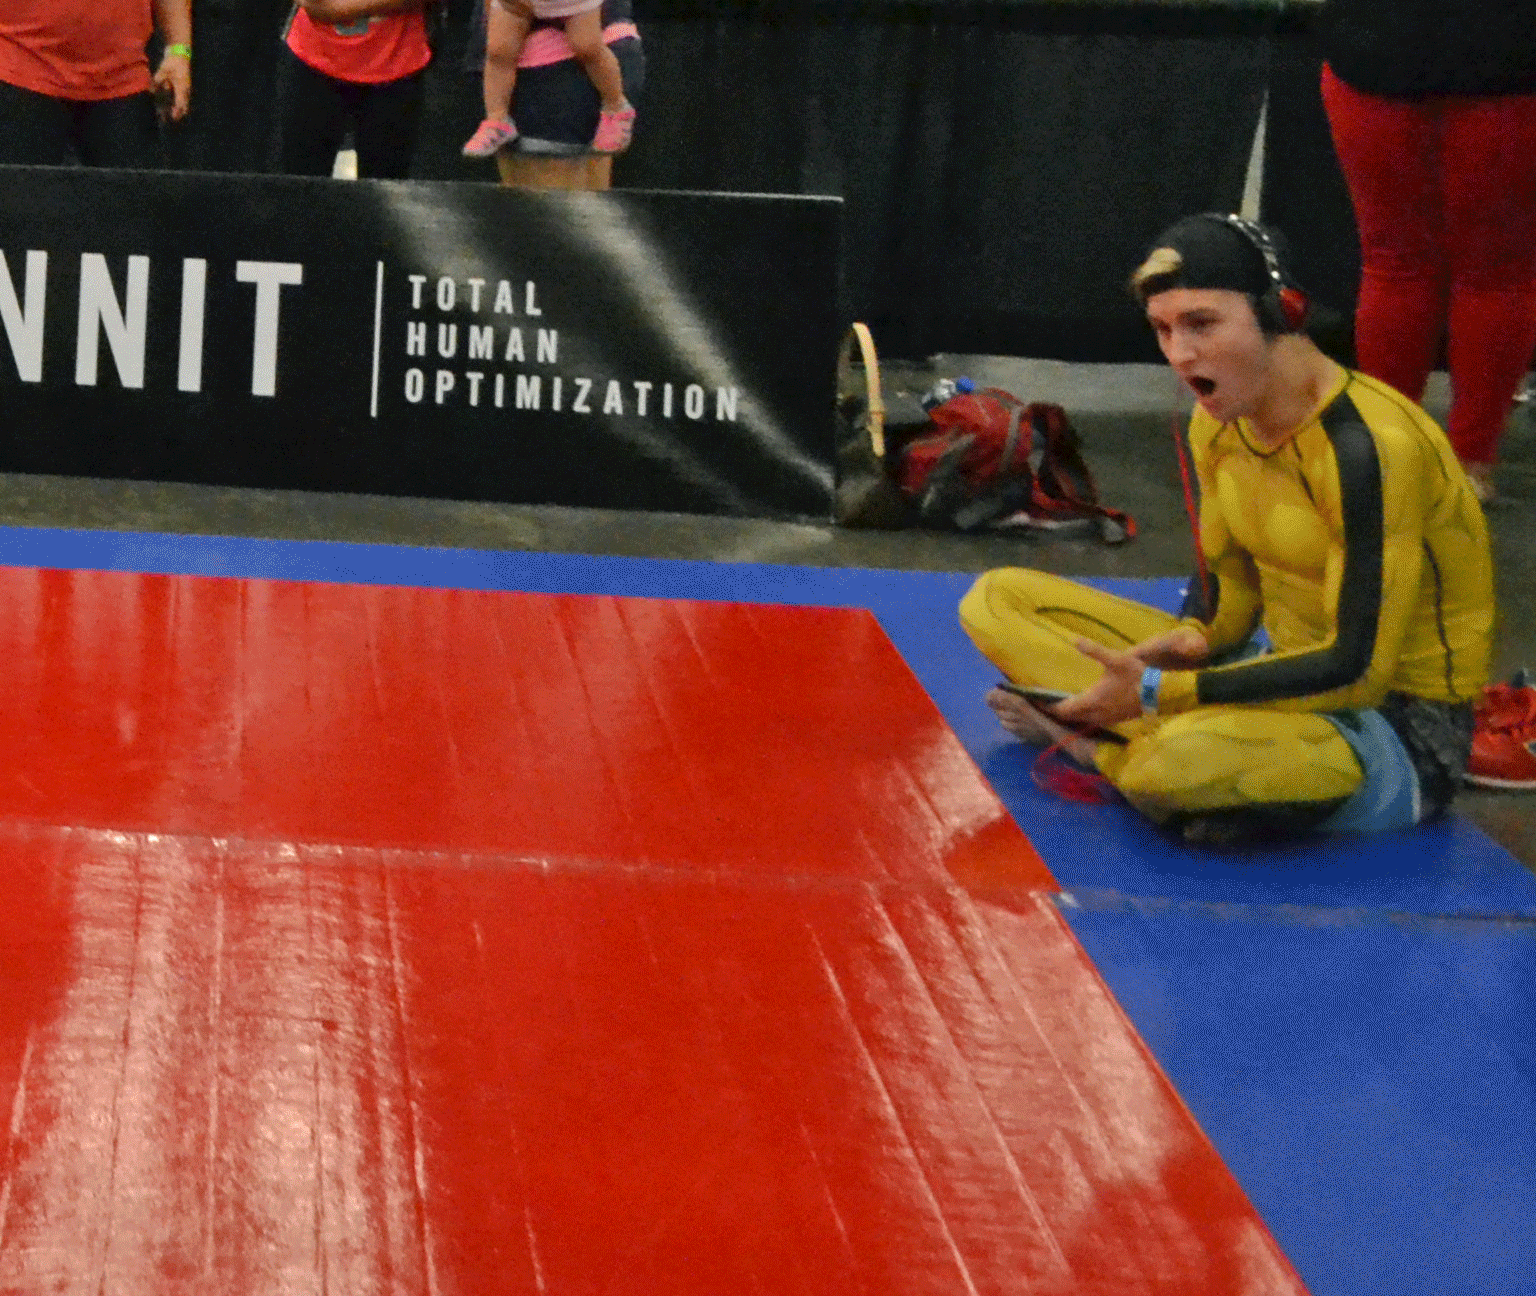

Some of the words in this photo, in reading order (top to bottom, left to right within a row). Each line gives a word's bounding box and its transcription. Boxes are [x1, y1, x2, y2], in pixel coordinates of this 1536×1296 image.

[408, 274, 543, 316] TOTAL
[406, 321, 559, 364] HUMAN
[404, 368, 740, 423] OPTIMIZATION
